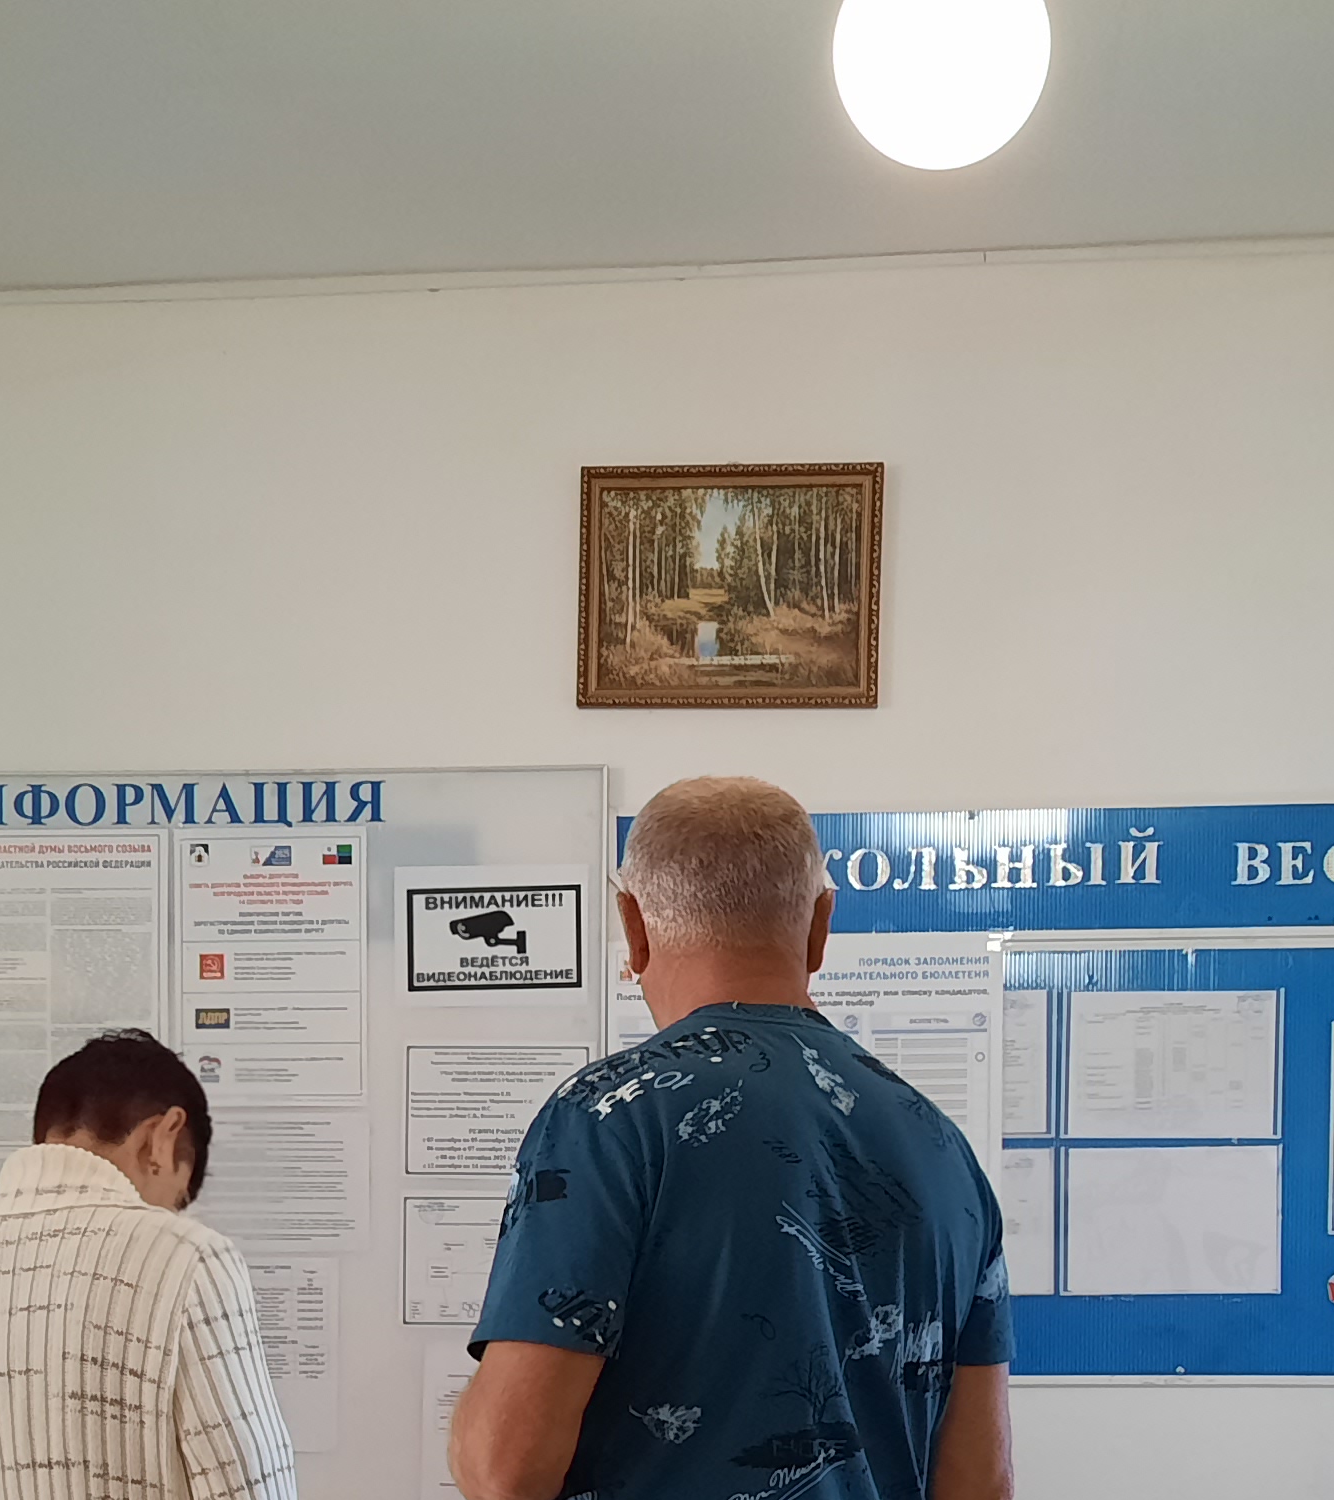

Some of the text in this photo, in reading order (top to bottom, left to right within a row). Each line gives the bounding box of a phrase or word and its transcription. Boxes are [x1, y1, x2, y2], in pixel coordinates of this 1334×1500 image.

[37, 845, 65, 855] ДУМЫ
[67, 844, 113, 854] ВОСЬМОГО
[116, 844, 152, 854] СОЗЫВА
[46, 858, 100, 869] РОССИЙСКОЙ
[102, 859, 152, 869] ФЕДЕРАЦИИ
[821, 827, 1164, 890] КОЛЬНЫЙ
[424, 892, 564, 911] ВНИМАНИЕ!!!
[459, 954, 530, 969] ВЕДЁТСЯ
[858, 955, 989, 967] ПОРЯДОК ЗАПОЛНЕНИЯ
[416, 968, 574, 984] ВИДЕОНАБЛЮДЕНИЕ
[818, 970, 989, 981] ИЗБИРАТЕЛЬНОГО БЮЛЛЕТЕНЯ
[198, 1012, 229, 1025] ЛДПР
